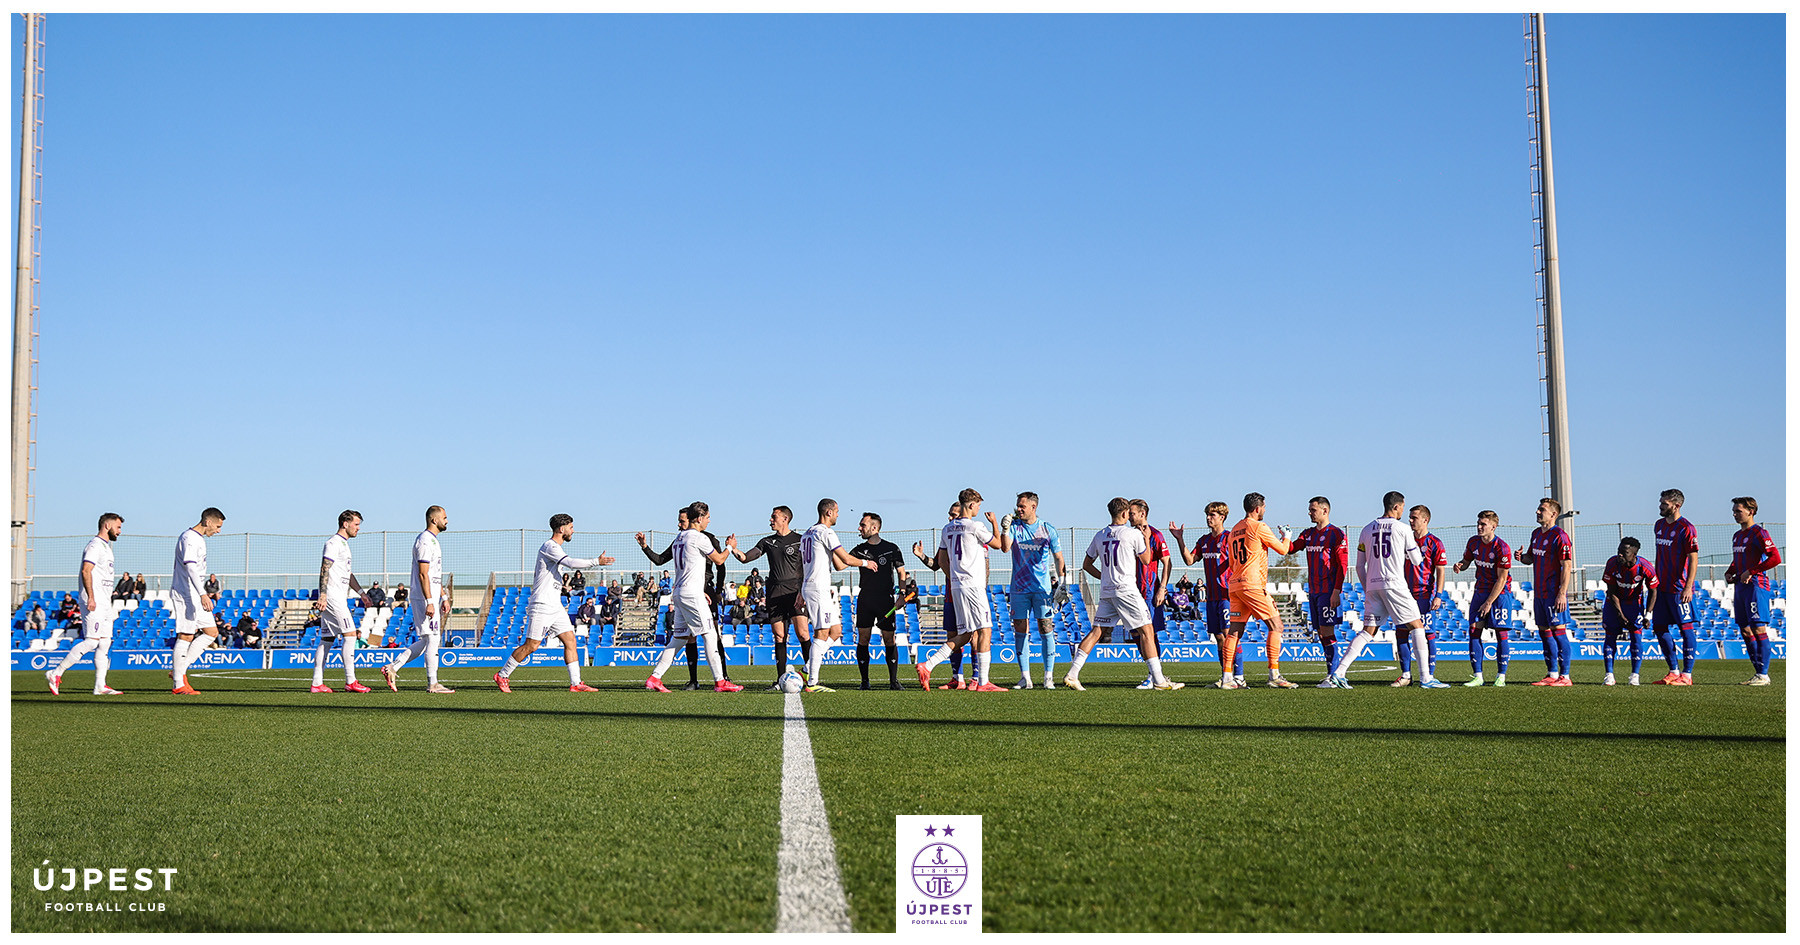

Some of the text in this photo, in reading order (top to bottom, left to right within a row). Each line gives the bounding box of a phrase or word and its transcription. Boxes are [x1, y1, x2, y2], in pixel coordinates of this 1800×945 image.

[1372, 532, 1391, 558] 35
[1102, 540, 1120, 567] 37
[1322, 606, 1335, 618] 25
[1678, 602, 1690, 616] 19
[1750, 601, 1758, 613] 8
[1494, 608, 1508, 620] 28
[94, 622, 99, 633] 9
[429, 620, 439, 632] 44
[1160, 647, 1214, 658] ARENA
